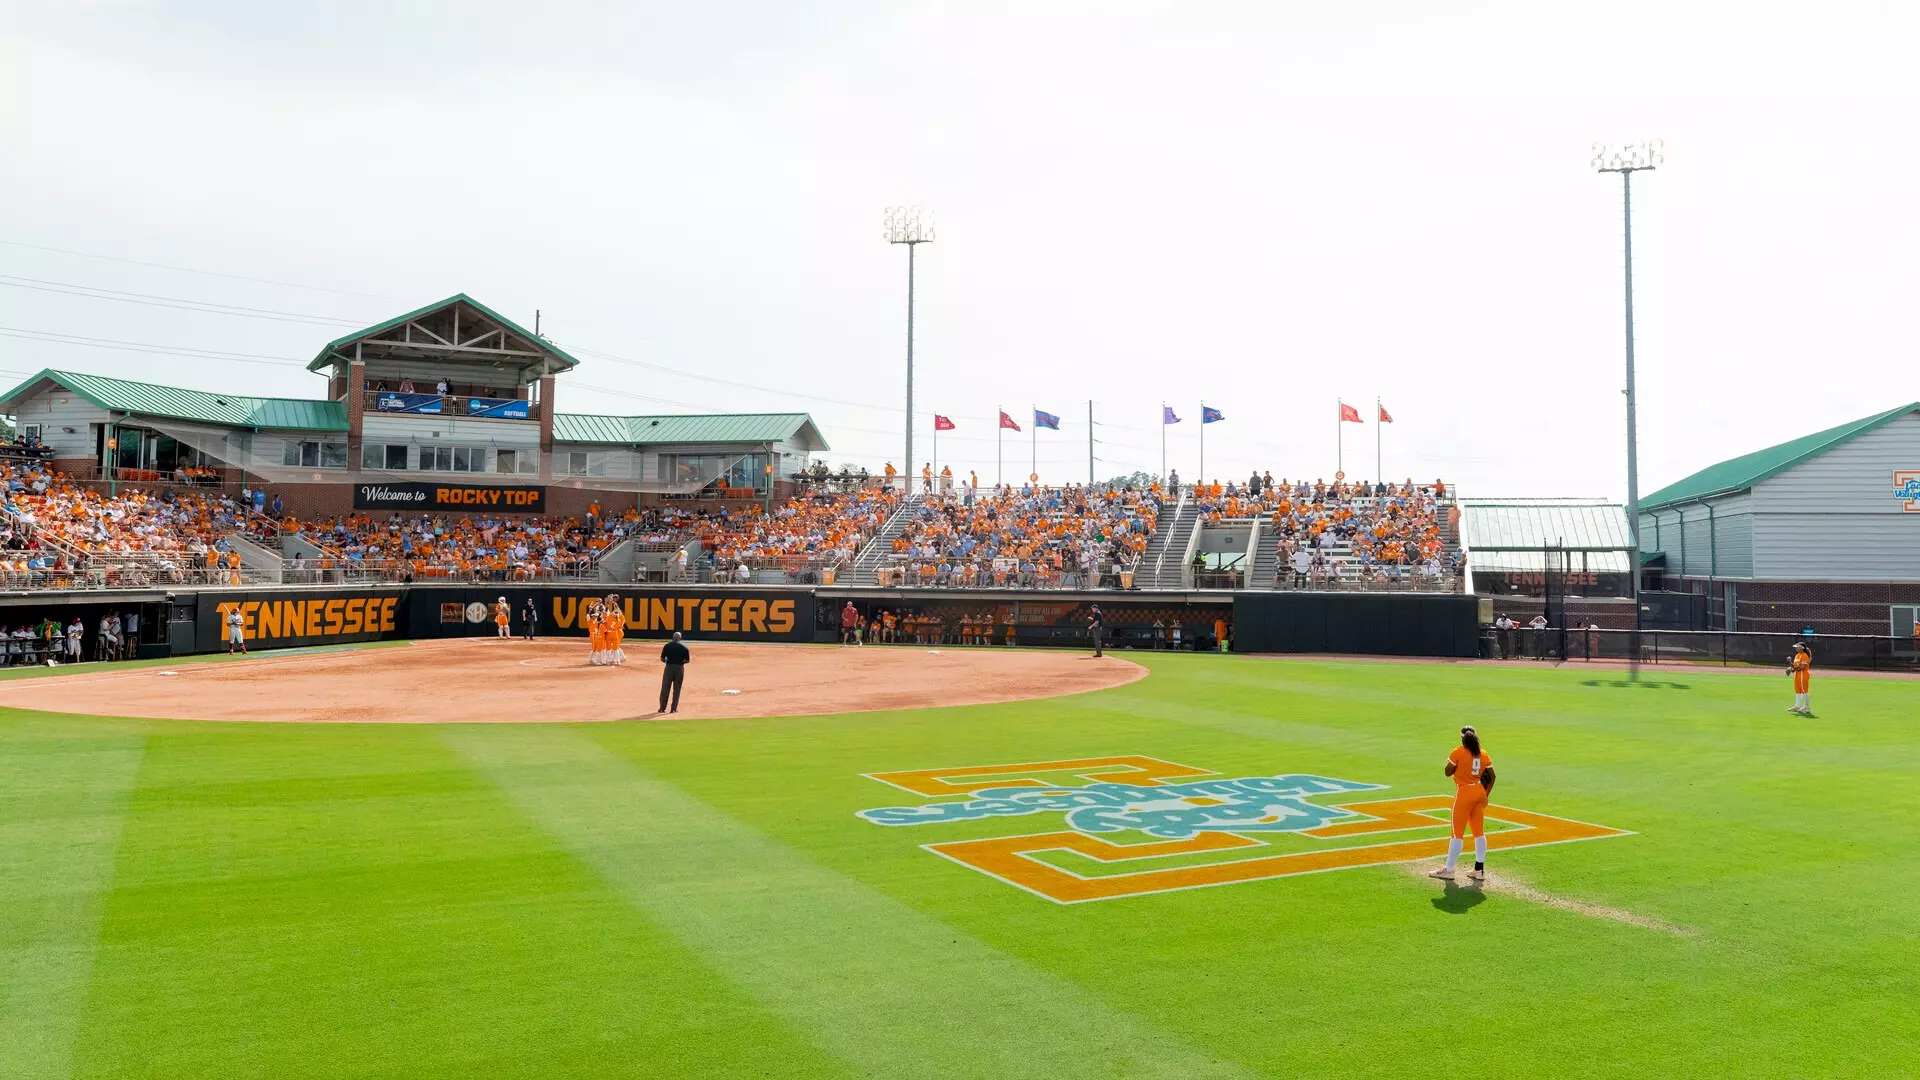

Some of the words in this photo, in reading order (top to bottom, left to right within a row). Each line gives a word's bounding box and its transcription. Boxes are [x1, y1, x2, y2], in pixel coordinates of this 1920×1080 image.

[362, 486, 413, 501] Welcome
[415, 491, 426, 501] to
[436, 488, 501, 504] ROCKY
[503, 490, 539, 505] TOP
[216, 598, 398, 640] TENNESSEE
[553, 597, 795, 632] VOUNTEERS
[610, 621, 616, 629] 2
[1471, 758, 1481, 776] 9
